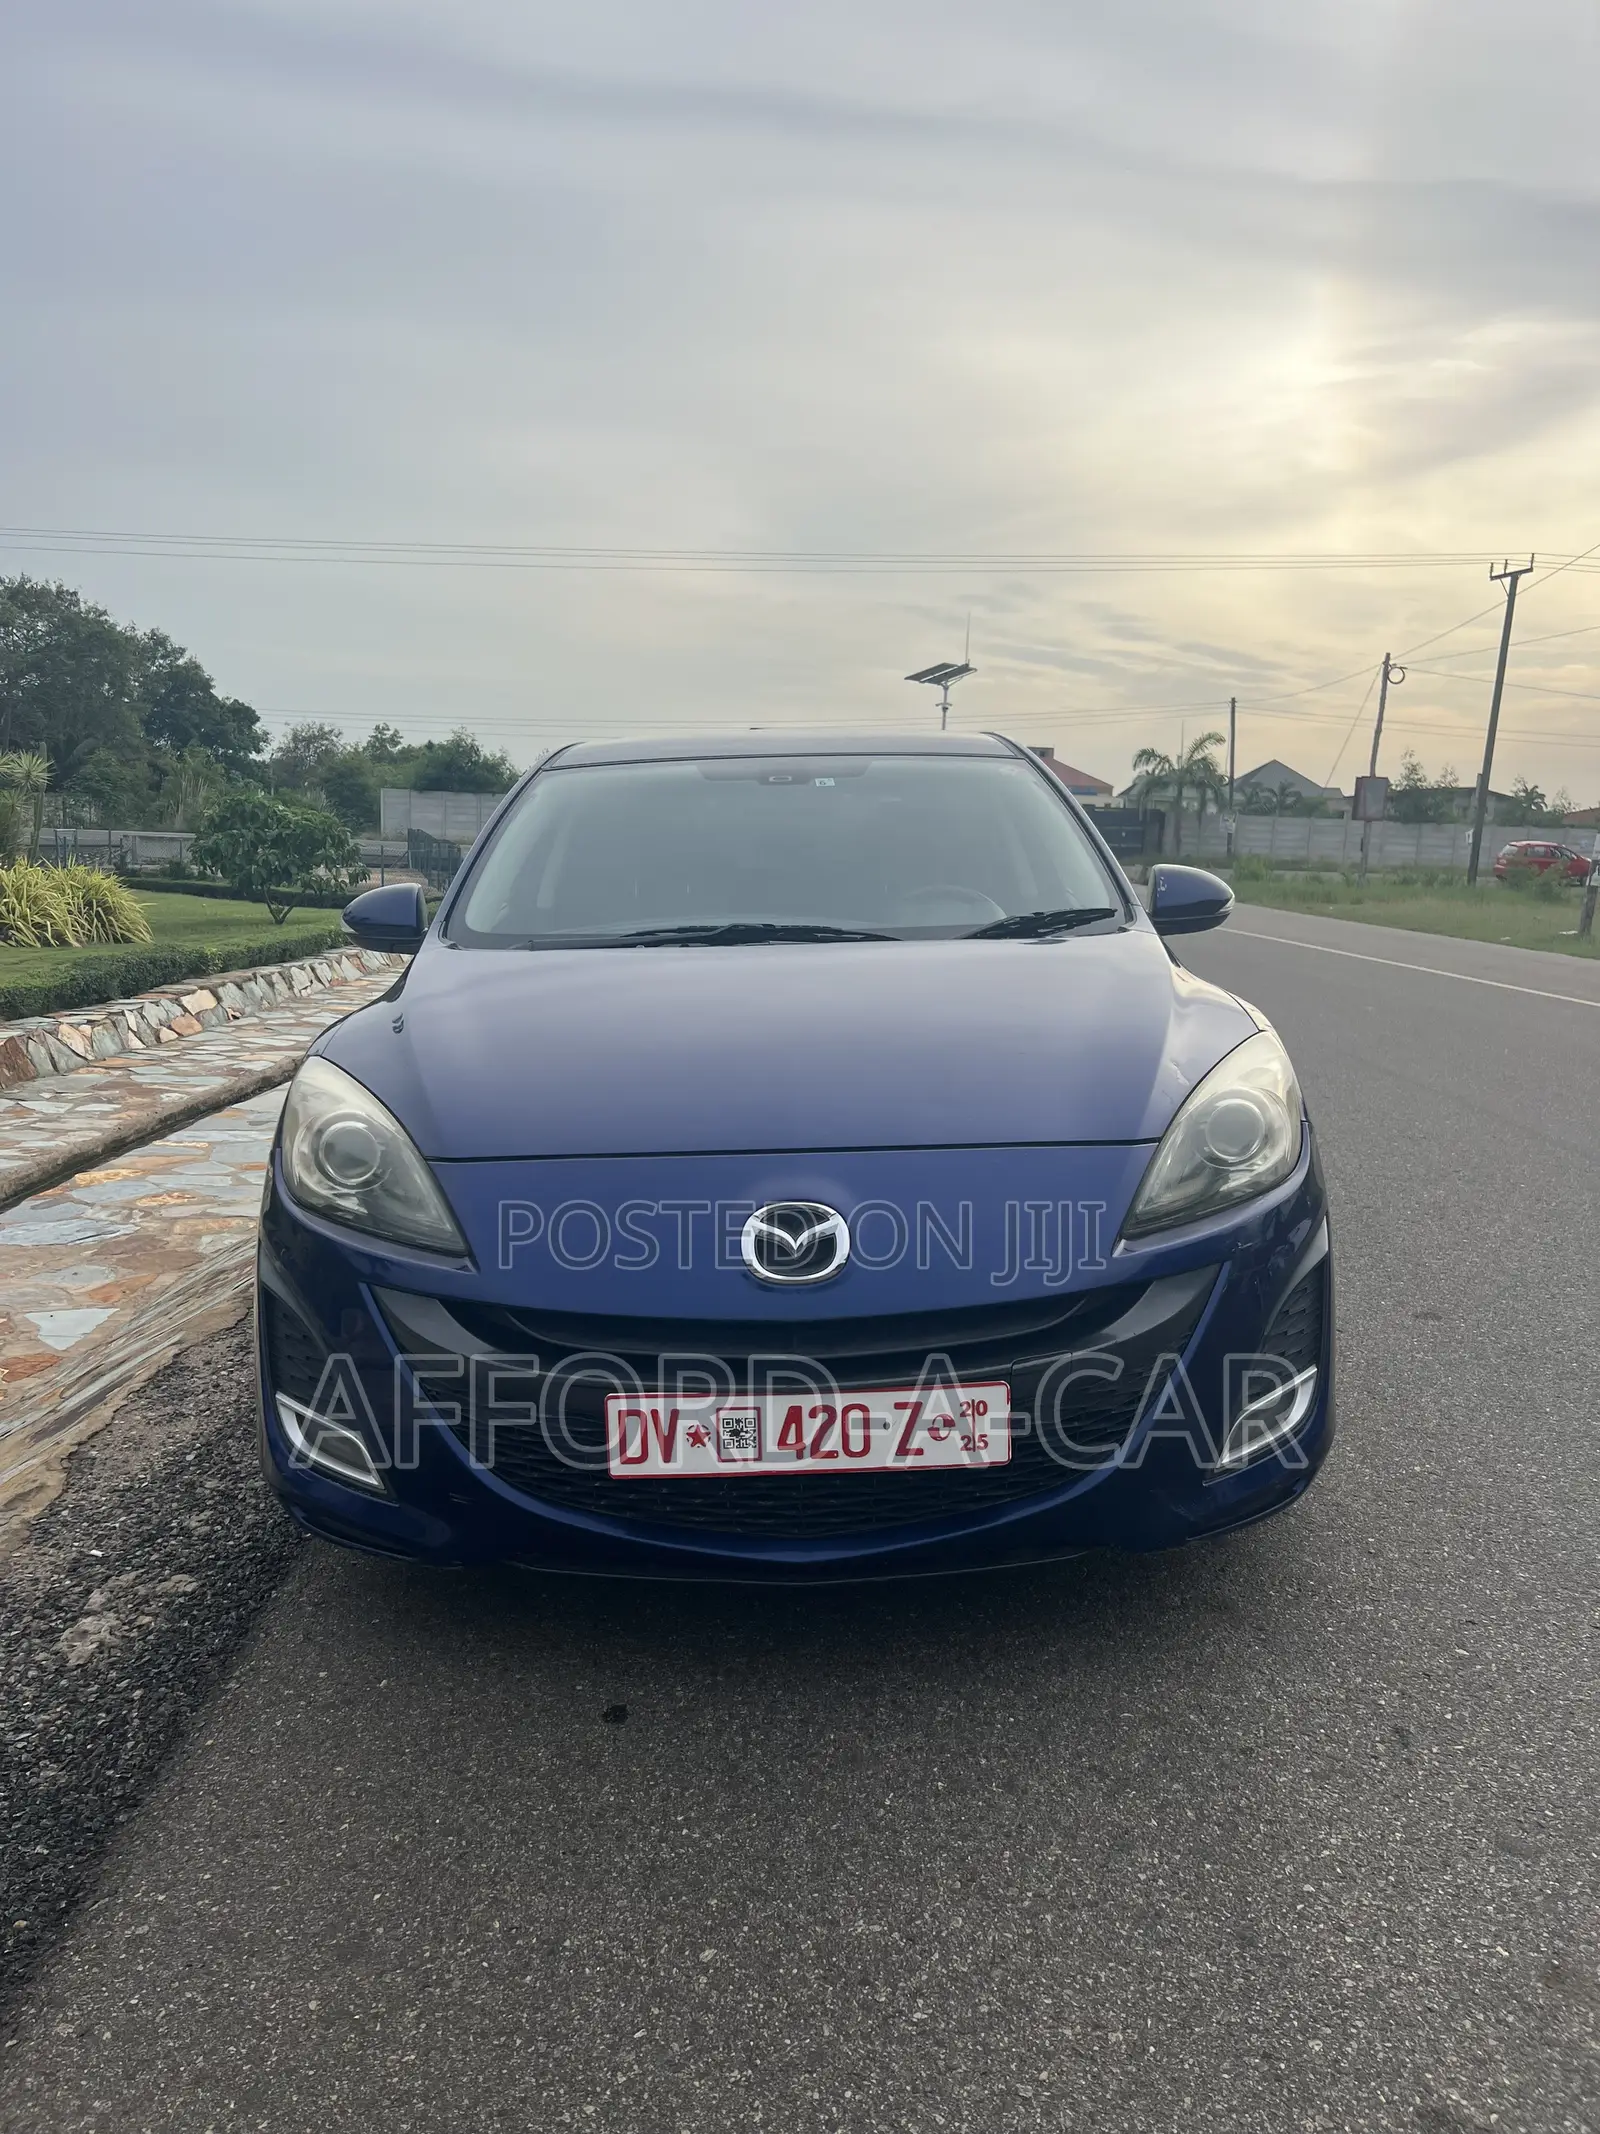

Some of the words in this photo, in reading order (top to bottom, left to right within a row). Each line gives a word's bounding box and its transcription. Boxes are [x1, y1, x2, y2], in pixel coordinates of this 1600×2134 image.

[618, 1408, 680, 1464] DV
[777, 1403, 871, 1459] 420
[894, 1401, 924, 1456] Z
